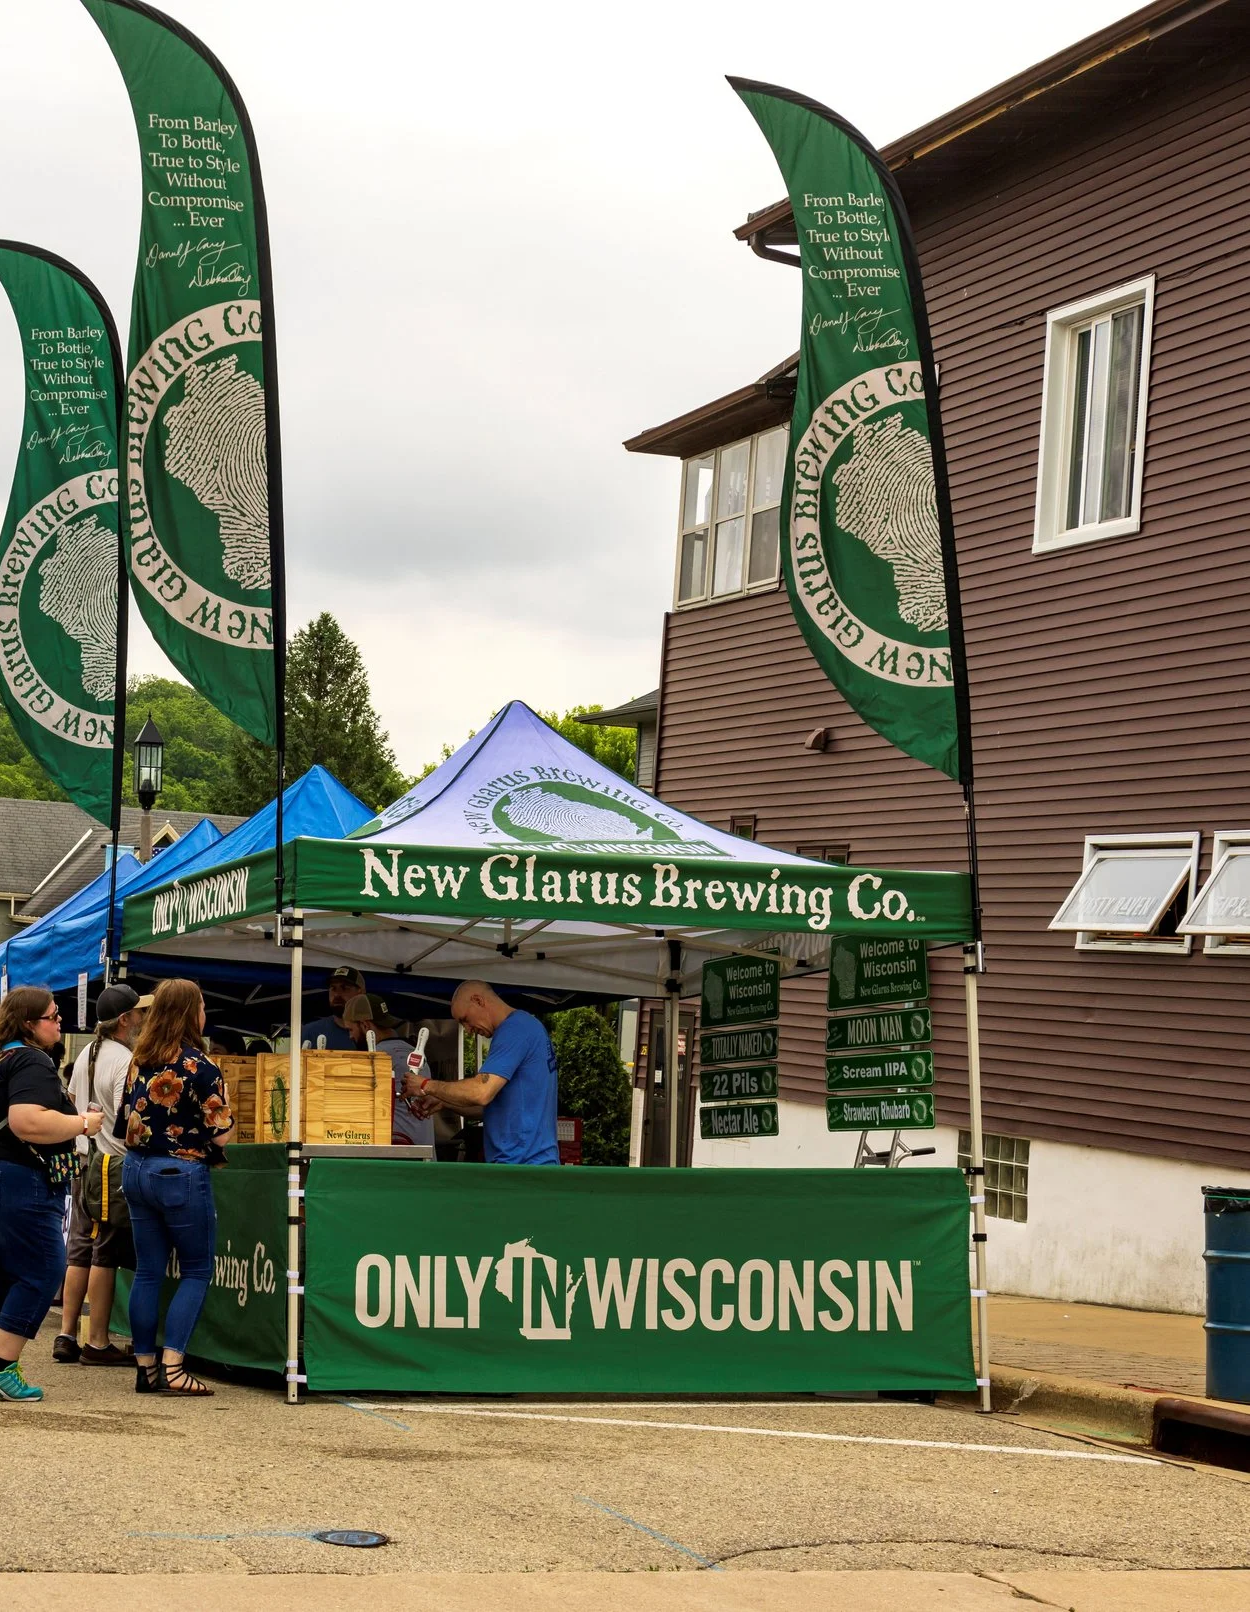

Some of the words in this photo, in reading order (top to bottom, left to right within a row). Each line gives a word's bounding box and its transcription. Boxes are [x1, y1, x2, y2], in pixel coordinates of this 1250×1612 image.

[148, 113, 189, 130] From
[194, 116, 237, 139] Barley
[159, 134, 178, 148] To
[181, 134, 225, 153] Bottle,
[149, 153, 184, 168] True
[188, 154, 203, 169] to
[206, 156, 240, 175] Style
[166, 172, 226, 190] Without
[148, 192, 244, 212] Compromise
[804, 193, 843, 207] From
[190, 212, 224, 228] Ever
[814, 211, 832, 225] To
[836, 211, 881, 226] Bottle,
[806, 230, 839, 243] True
[844, 230, 858, 242] to
[823, 248, 883, 260] Without
[808, 267, 900, 283] Compromise
[848, 284, 881, 297] Ever
[31, 328, 64, 340] From
[67, 328, 104, 342] Barley
[38, 343, 55, 354] To
[57, 342, 94, 355] Bottle,
[31, 357, 58, 369] True
[61, 358, 73, 369] to
[76, 357, 104, 371] Style
[43, 373, 93, 385] Without
[30, 388, 107, 404] Compromise
[61, 404, 90, 415] Ever
[796, 532, 864, 648] Glarus
[467, 769, 531, 810] Glarus
[463, 810, 498, 837] New
[359, 848, 470, 899] New
[480, 854, 642, 906] Glarus
[650, 863, 833, 930] Brewing
[847, 873, 915, 922] Co.
[152, 890, 174, 935] ONLY
[188, 867, 249, 925] WISCONSIN
[860, 939, 904, 958] Welcome
[908, 939, 919, 950] to
[726, 964, 762, 982] Welcome
[765, 961, 774, 974] to
[863, 958, 917, 978] Wisconsin
[729, 981, 771, 1000] Wisconsin
[860, 986, 871, 997] New
[871, 984, 889, 996] Glarus
[890, 981, 912, 995] Brewing
[847, 1018, 877, 1045] MOON
[880, 1015, 904, 1041] MAN
[711, 1034, 739, 1060] TOTALLY
[739, 1031, 763, 1057] NAKED
[842, 1065, 882, 1079] Scream
[884, 1061, 908, 1076] IIPA
[712, 1073, 729, 1097] 22
[732, 1071, 759, 1094] Pils
[711, 1109, 742, 1135] Nectar
[742, 1107, 759, 1133] Ale
[843, 1101, 880, 1126] Strawberry
[880, 1099, 911, 1120] Rhubarb
[327, 1130, 344, 1139] New
[345, 1130, 370, 1140] Glarus
[210, 1239, 249, 1306] wing
[253, 1241, 276, 1294] Co.
[355, 1254, 494, 1328] ONLY
[500, 1238, 576, 1340] IN
[584, 1256, 912, 1333] WISCONSIN
